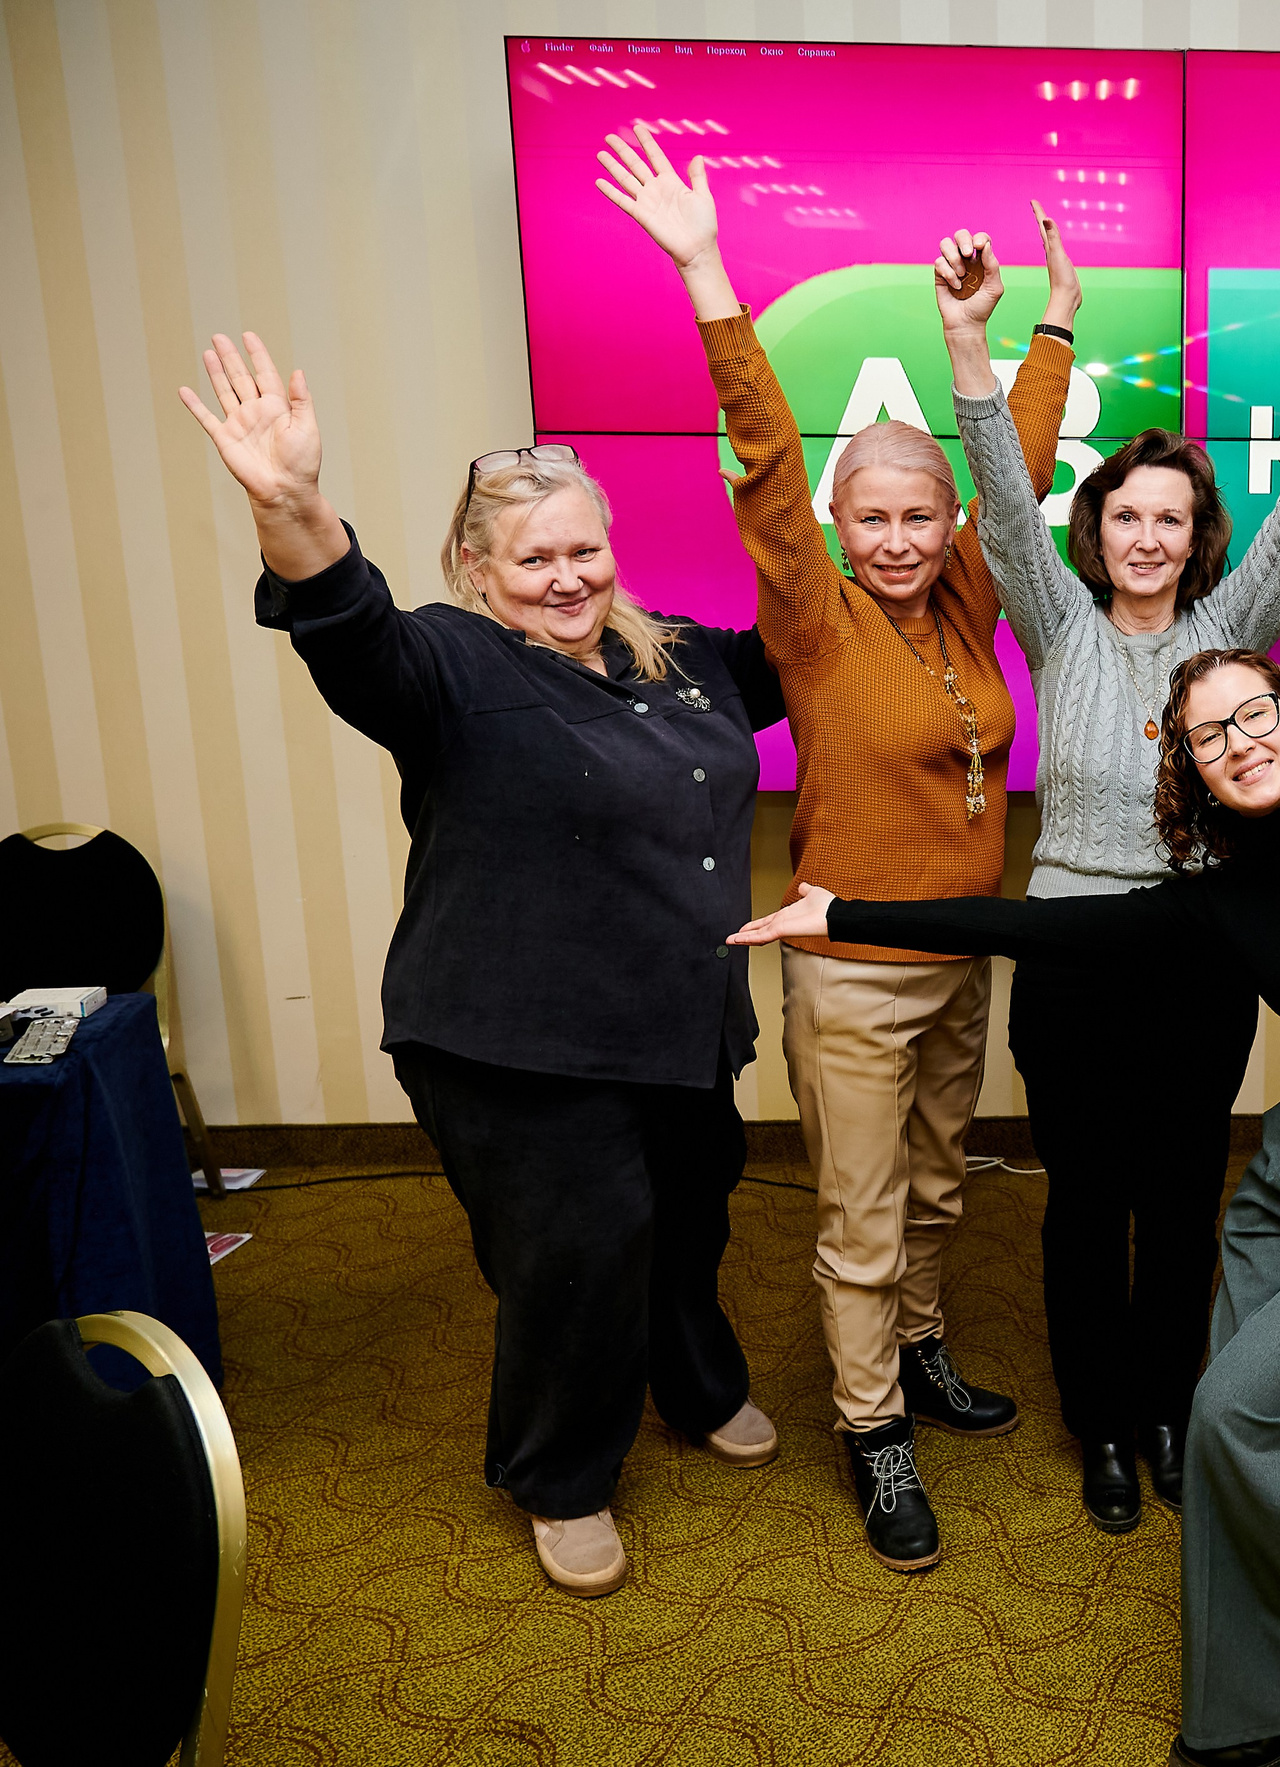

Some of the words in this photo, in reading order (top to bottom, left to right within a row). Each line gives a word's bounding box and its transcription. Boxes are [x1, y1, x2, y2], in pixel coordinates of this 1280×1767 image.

[544, 42, 575, 52] Finder
[589, 43, 614, 53] Файл
[627, 44, 661, 55] Правка
[674, 44, 693, 56] Вид
[706, 45, 747, 57] Переход
[760, 46, 784, 56] Окно
[797, 47, 836, 58] Справка
